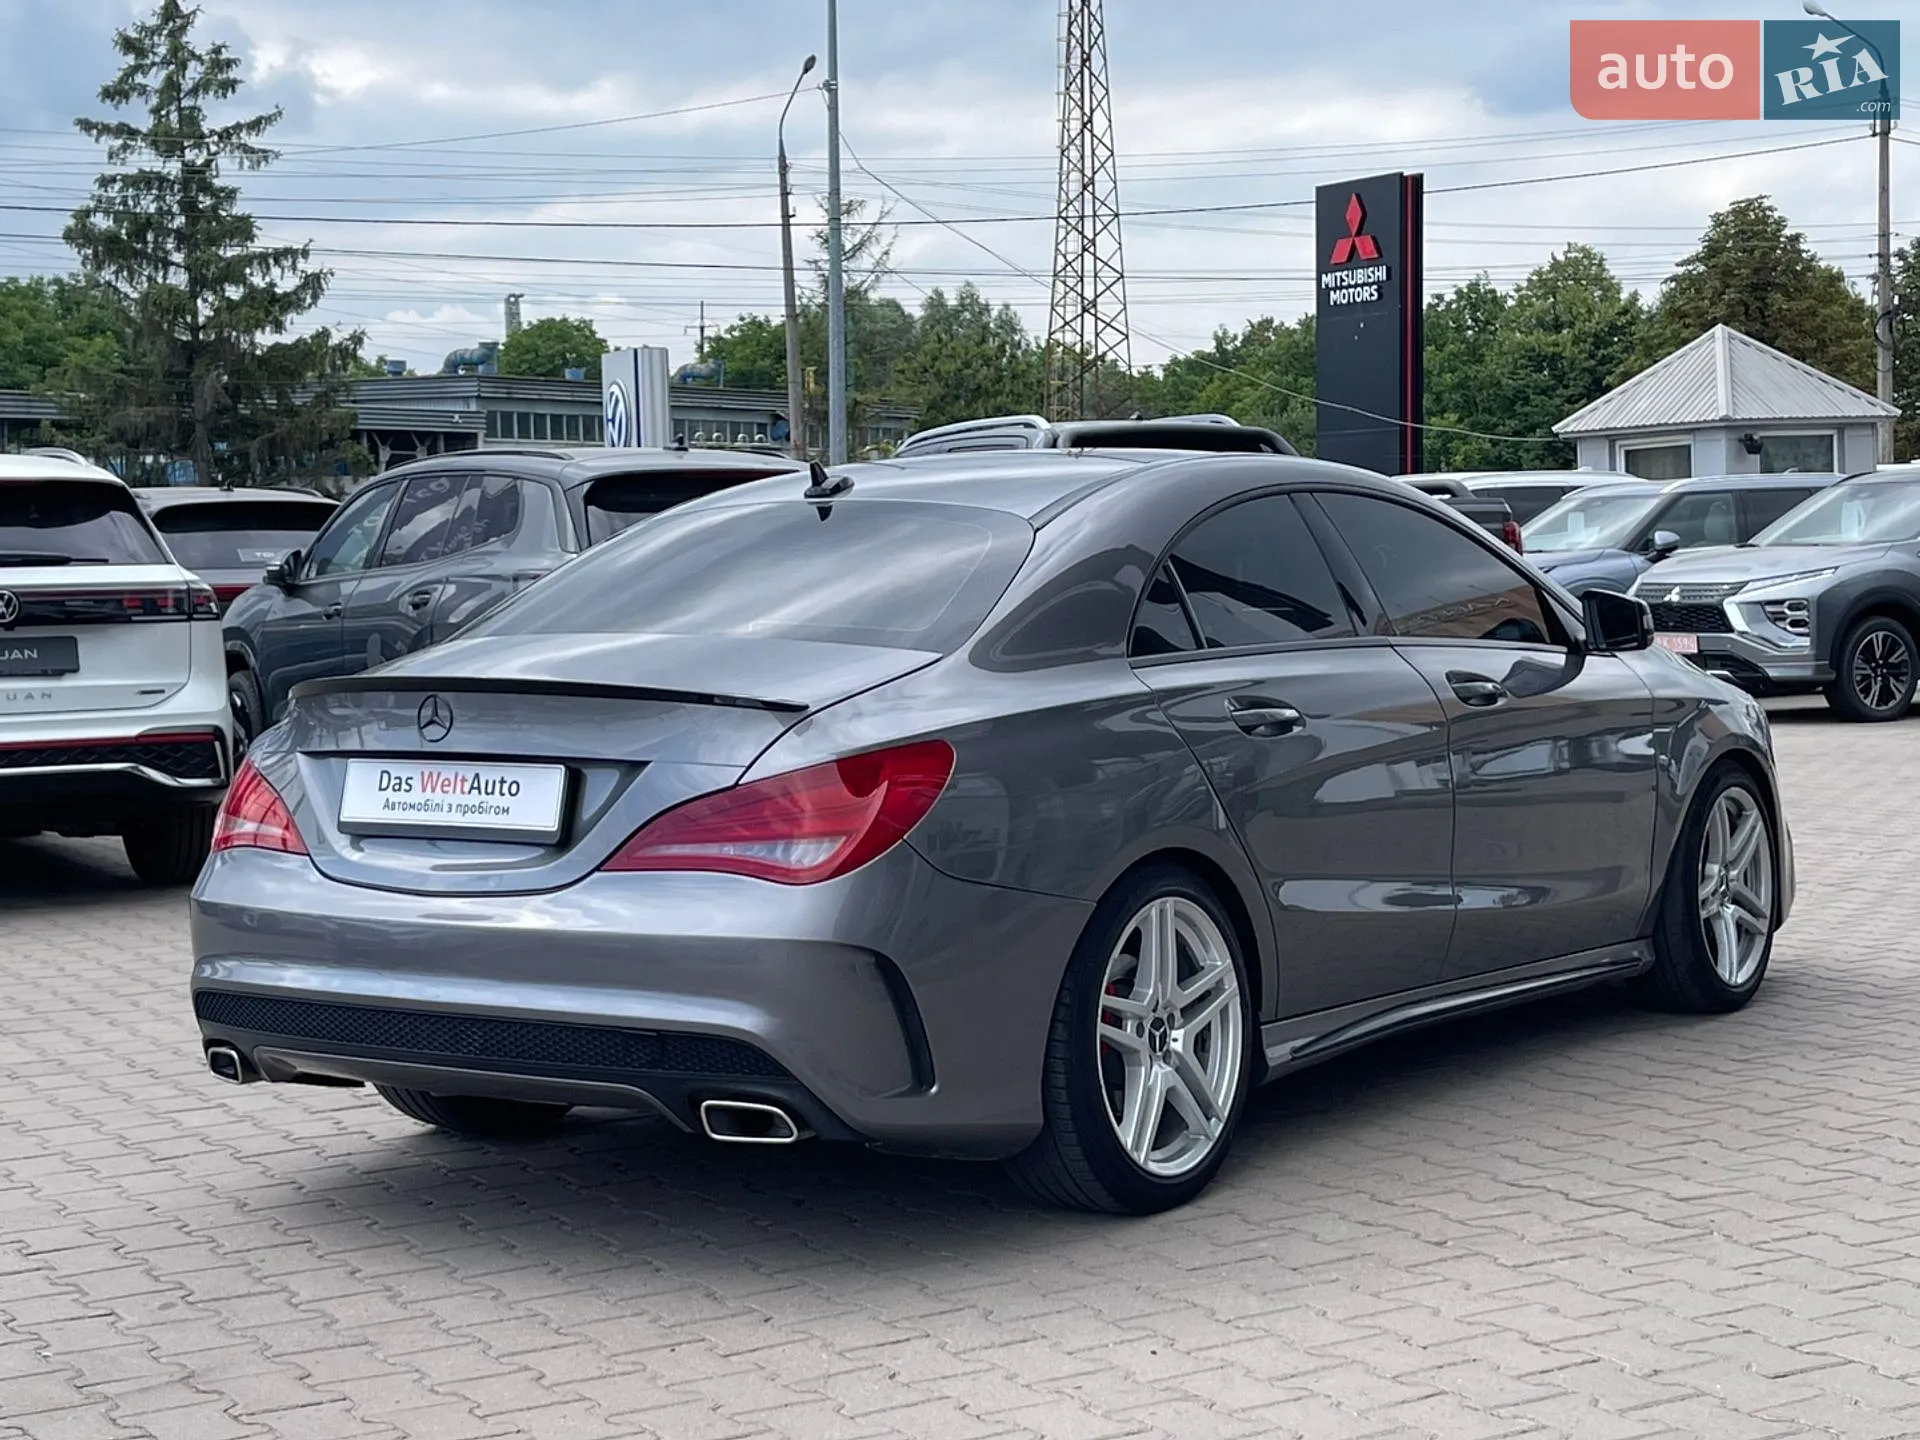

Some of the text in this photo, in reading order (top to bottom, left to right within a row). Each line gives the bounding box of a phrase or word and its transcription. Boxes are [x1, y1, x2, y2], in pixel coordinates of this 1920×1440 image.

[1321, 265, 1387, 289] MITSUBISHI
[1329, 285, 1378, 306] MOTORS
[378, 770, 521, 797] Das WeltAuto
[382, 798, 510, 816] Автомобілі з пробігом
